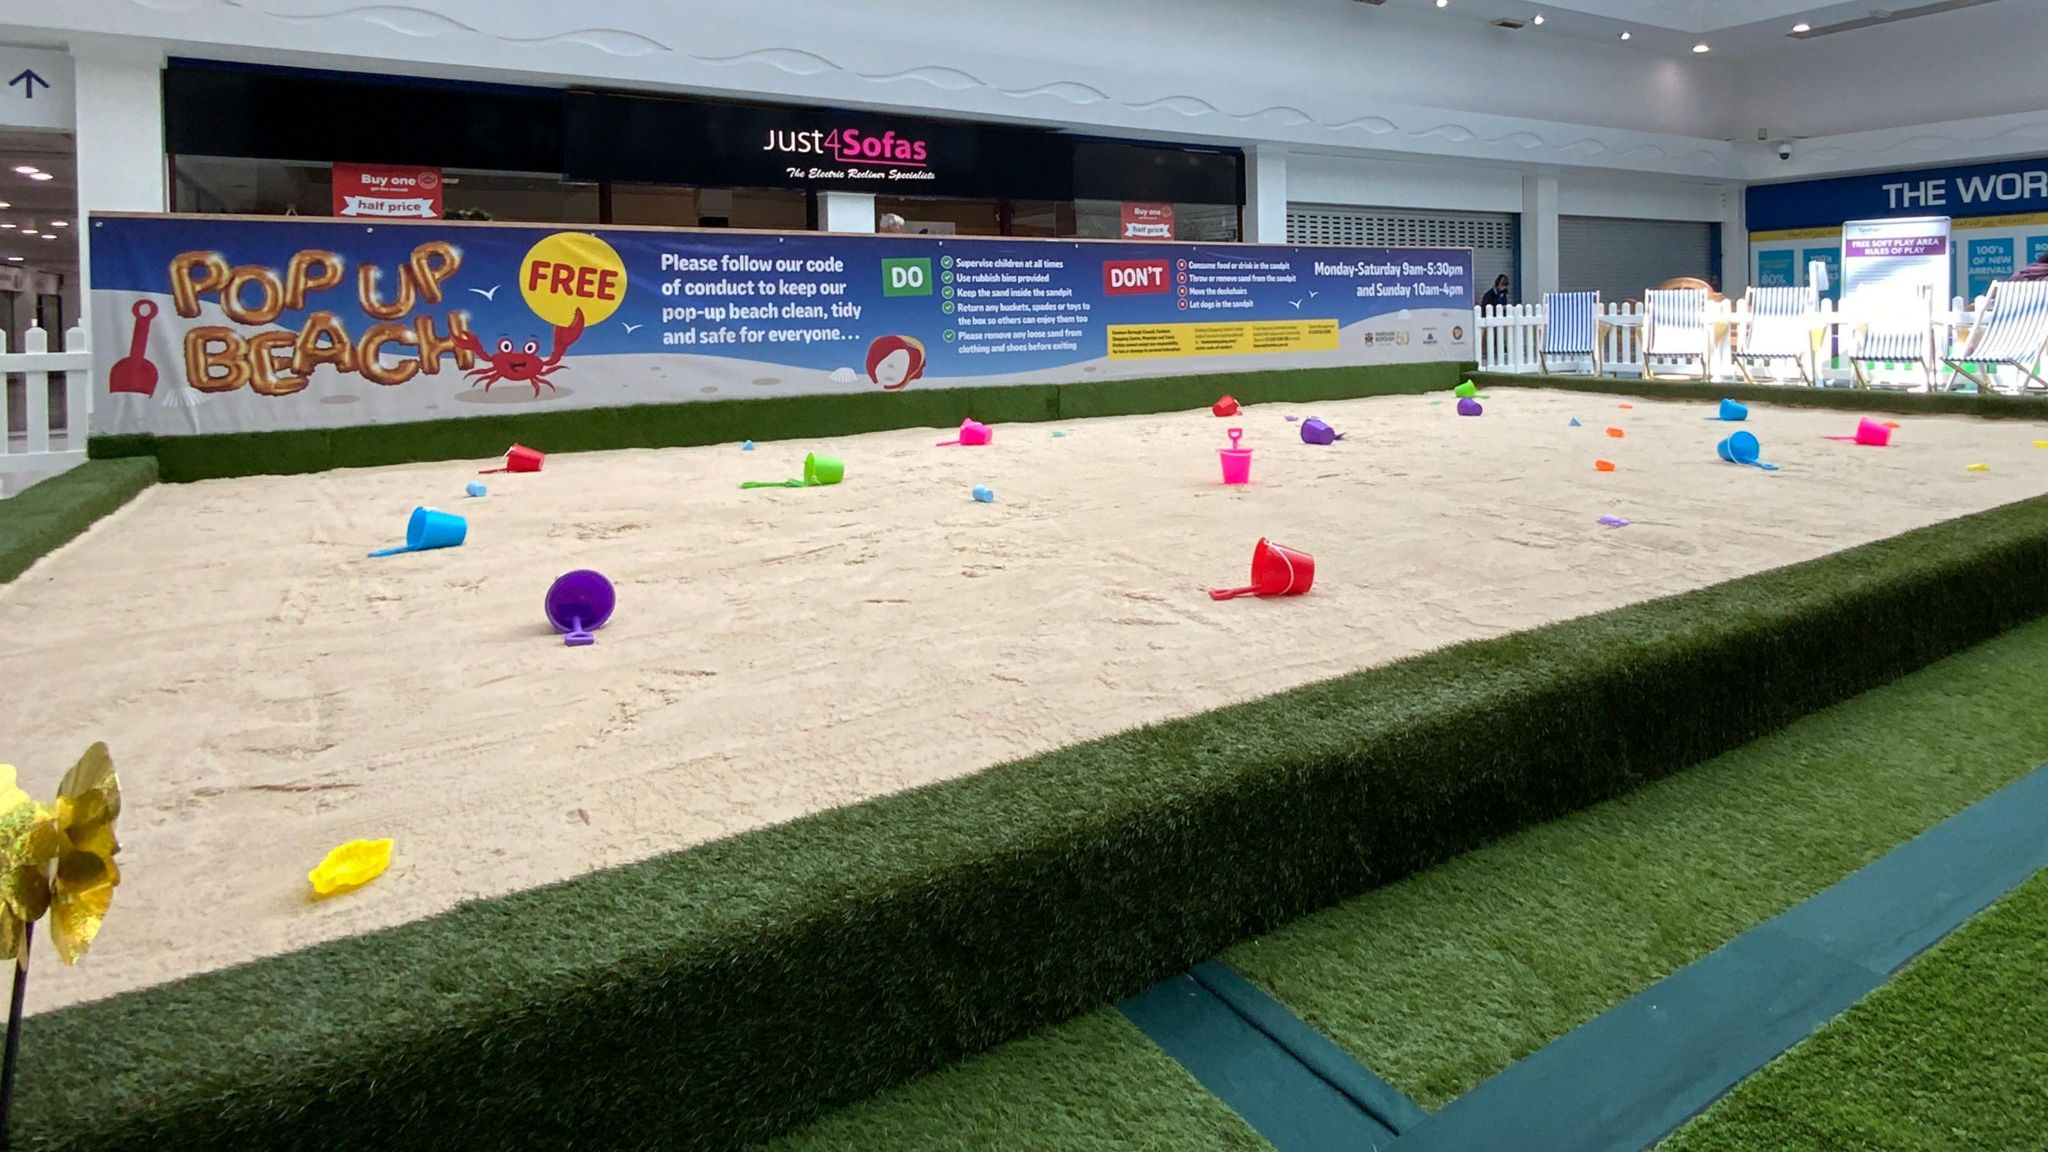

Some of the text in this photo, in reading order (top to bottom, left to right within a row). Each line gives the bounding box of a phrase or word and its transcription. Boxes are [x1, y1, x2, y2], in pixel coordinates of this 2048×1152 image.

[763, 128, 928, 162] Just4Sofas
[361, 174, 416, 186] Buy one
[786, 168, 936, 180] The Electric Recliner Specialists
[1882, 171, 2048, 208] THE WOR
[358, 200, 421, 212] half price
[1134, 208, 1148, 216] Buy
[1852, 238, 1939, 248] FREE SOFT PLAY AREA
[1864, 246, 1925, 255] RULES OF PLAY
[1976, 245, 2004, 255] 100's
[661, 253, 844, 272] Please follow our code
[956, 258, 1064, 269] Supervise children at all times
[1188, 261, 1216, 270] Consume
[1216, 261, 1231, 269] food
[1238, 261, 1253, 270] drink
[1269, 262, 1290, 271] sandpit
[1972, 255, 2012, 265] OF NEW
[1314, 261, 1463, 278] Monday-Saturday 9am-5:30pm
[1968, 266, 2012, 275] ARRIVALS
[169, 240, 462, 325] POP UP
[528, 260, 618, 301] FREE
[891, 265, 924, 288] DO
[956, 273, 1050, 283] Use rubbish bins provided
[1110, 265, 1163, 288] DON'T
[1188, 274, 1208, 282] Throw
[1238, 274, 1252, 282] sand
[1252, 274, 1266, 282] from
[1266, 274, 1276, 282] the
[1276, 274, 1297, 283] sandpit
[661, 278, 847, 298] of conduct to keep our
[956, 287, 1073, 298] Keep the sand inside the sandpit
[1216, 287, 1248, 295] deckchairs
[1357, 282, 1463, 298] and Sunday 10am-4pm
[957, 303, 984, 312] Return
[985, 304, 999, 313] any
[999, 302, 1031, 312] buckets,
[1032, 302, 1057, 312] spades
[1066, 302, 1082, 312] toys
[1082, 302, 1091, 310] to
[1189, 299, 1254, 309] Let dogs in the sandpit
[662, 301, 862, 323] pop-up beach clean, tidy
[958, 315, 1088, 325] the box so others can enjoy them too
[662, 327, 696, 345] and
[699, 326, 736, 344] safe
[739, 326, 765, 343] for
[958, 329, 1082, 340] Please remove any loose sand from
[184, 310, 475, 396] BEACH
[958, 341, 1077, 354] clothing and shoes before exiting
